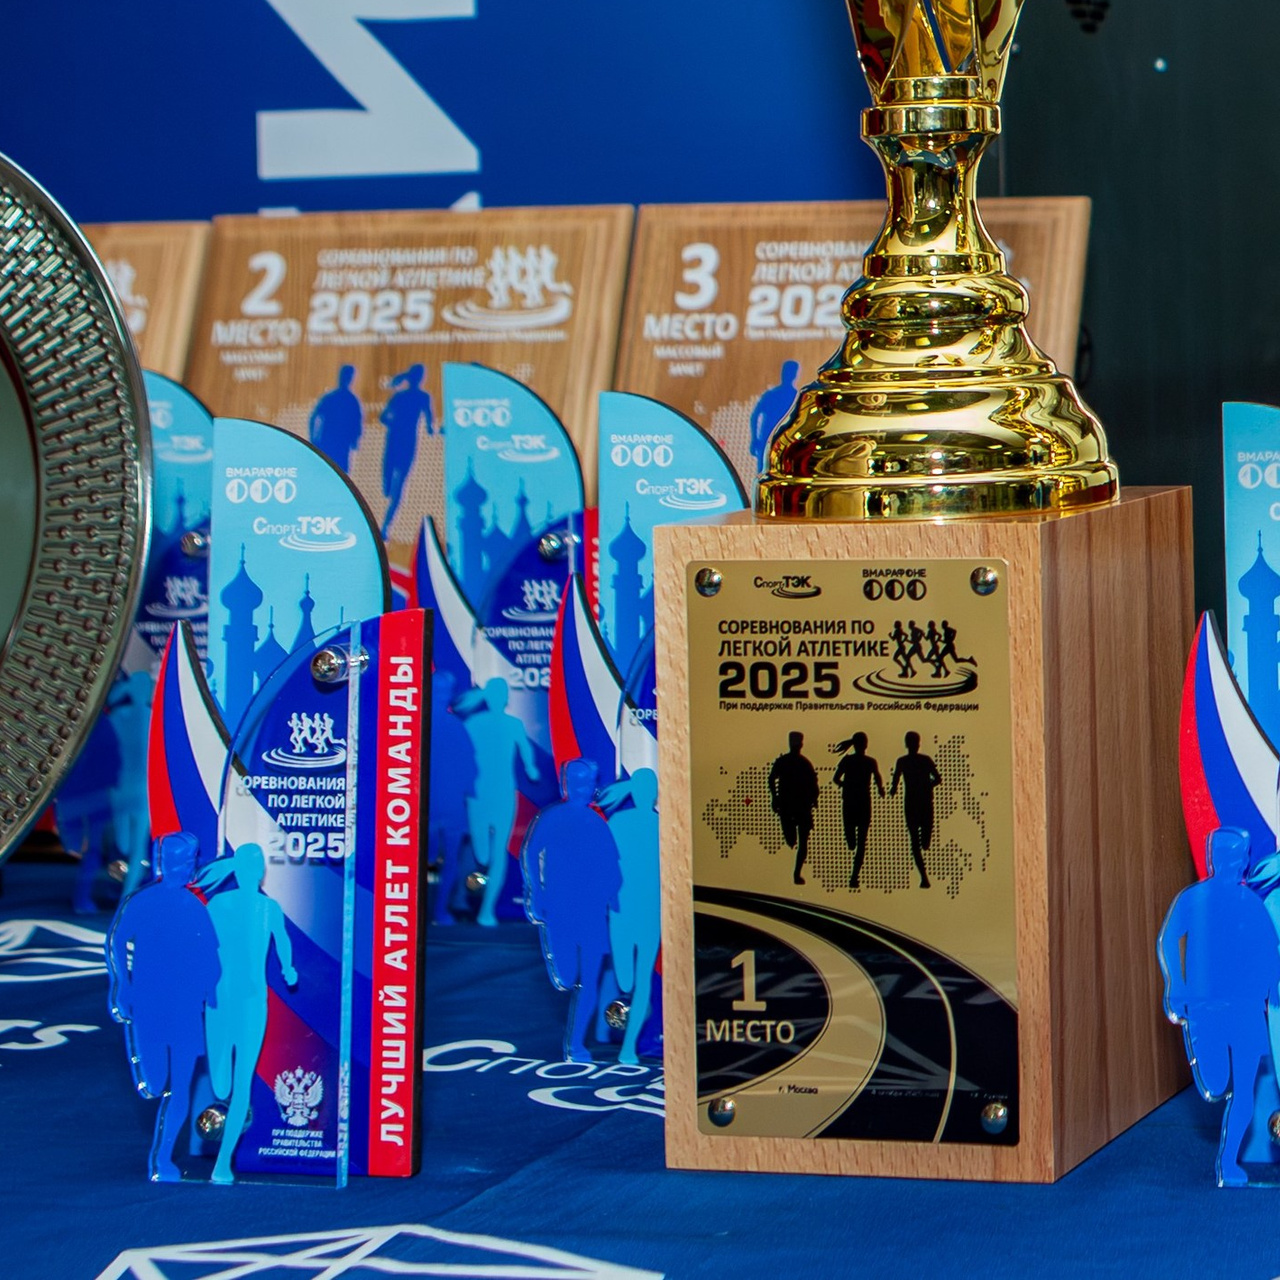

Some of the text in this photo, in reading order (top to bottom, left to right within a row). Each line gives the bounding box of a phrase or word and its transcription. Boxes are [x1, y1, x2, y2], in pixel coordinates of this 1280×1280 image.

[755, 240, 873, 261] СОРЕВНОВАН
[674, 242, 720, 310] 3
[752, 257, 865, 283] ЛЕГКОЙ АТ
[241, 250, 286, 316] 2
[308, 289, 435, 333] 2025
[211, 318, 301, 347] МЕСТО
[643, 312, 738, 341] МЕСТО
[225, 467, 298, 478] ВМАРАФОНЕ
[862, 568, 927, 578] ВМАРАФОНЕ
[483, 626, 555, 638] СОРЕВНОВАН
[718, 620, 874, 635] СОРЕВНОВАНИЯ ПО
[515, 653, 552, 665] АТЛЕТ
[718, 636, 890, 658] ЛЕГКОЙ АТЛЕТИКЕ
[718, 661, 841, 699] 2025
[719, 701, 980, 713] При поддержке Правительства Российской Федерации
[268, 793, 346, 809] ПО ЛЕГКОЙ
[276, 812, 345, 828] АТЛЕТИКЕ
[269, 831, 346, 859] 2025
[378, 655, 418, 1147] ЛУЧШИЙ АТЛЕТ КОМАНДЫ
[730, 949, 767, 1012] 1
[705, 1019, 795, 1044] МЕСТО
